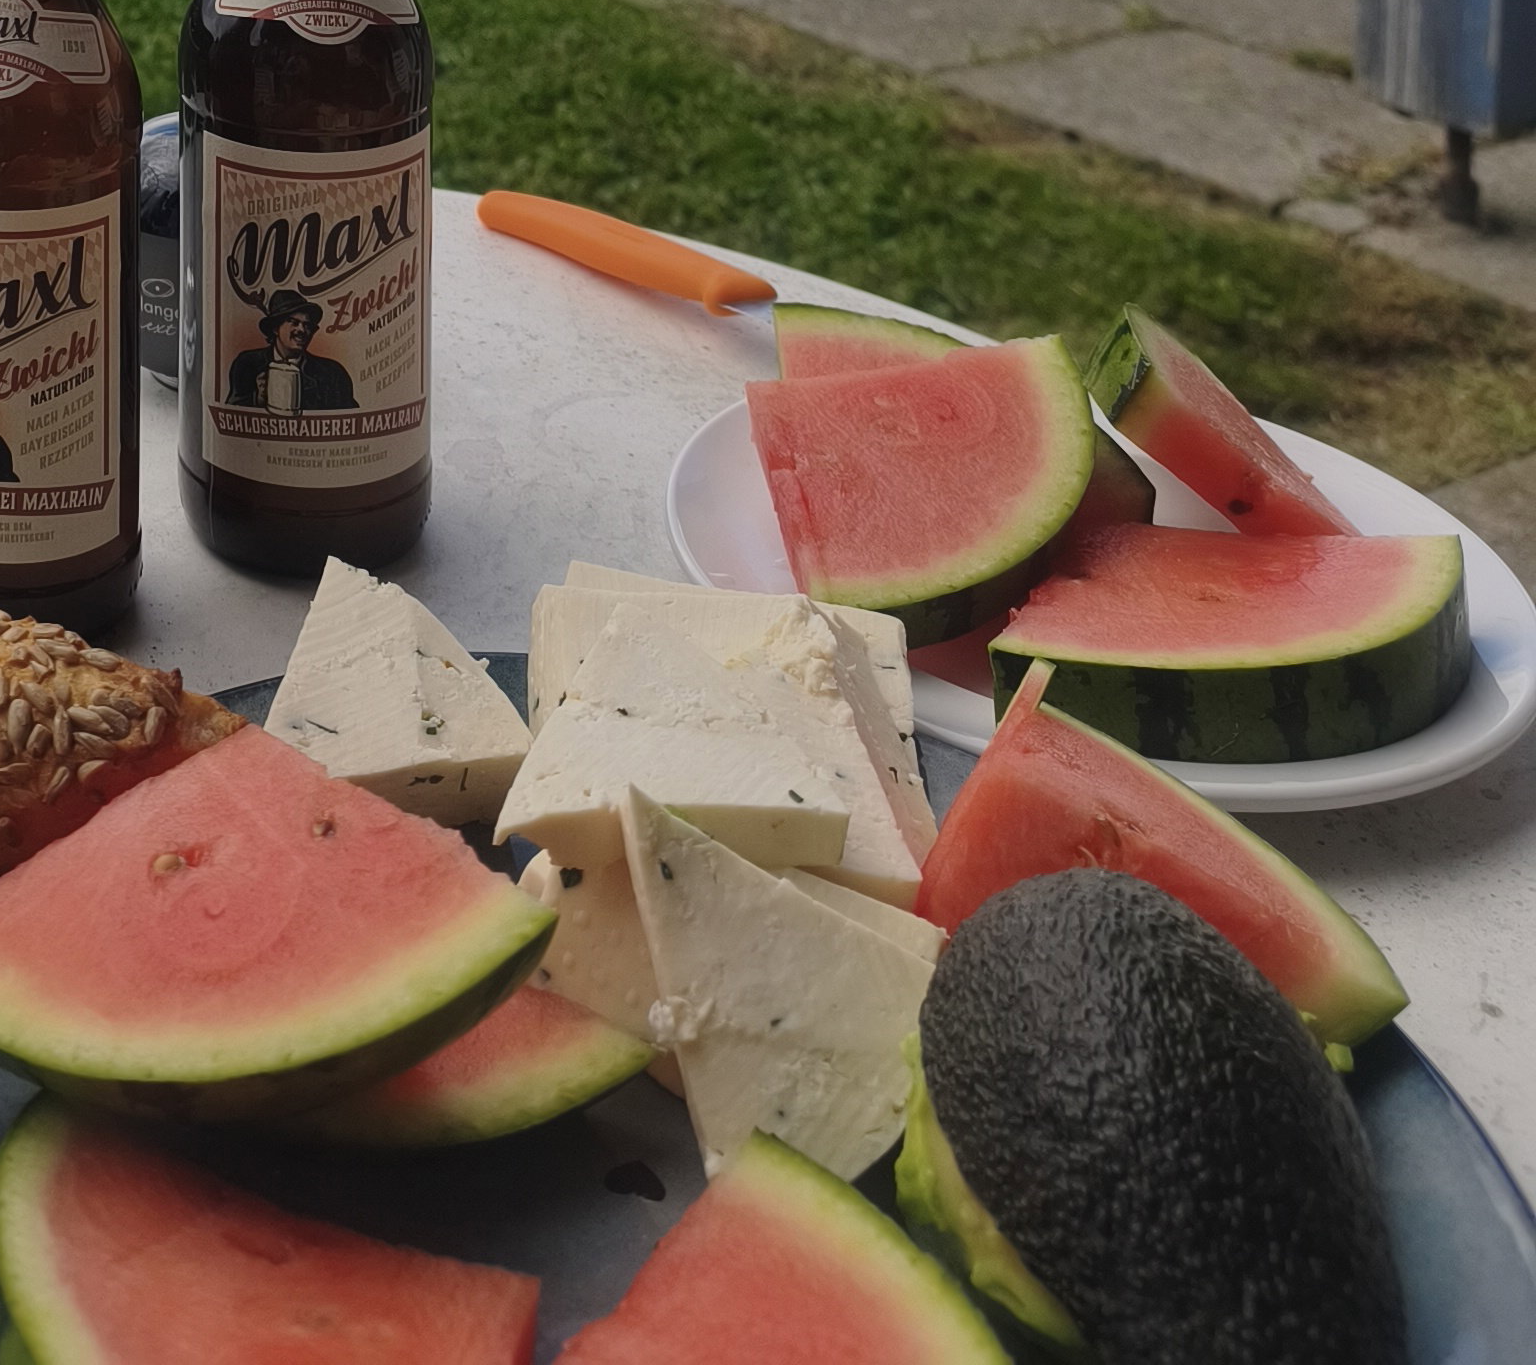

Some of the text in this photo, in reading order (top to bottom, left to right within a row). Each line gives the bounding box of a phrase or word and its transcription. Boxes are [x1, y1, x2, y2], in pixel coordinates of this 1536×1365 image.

[305, 14, 349, 27] ZWICKL
[247, 190, 321, 216] ORIGINAL
[227, 169, 417, 296] Maxl
[325, 247, 420, 334] Zwickl
[26, 390, 95, 433] NACH ALTER
[218, 404, 422, 438] SCHLOSSBRAUEREI MAXLRAIN
[20, 410, 95, 456] BAYERISCHER
[39, 430, 95, 470] REZEPTUR
[22, 484, 104, 512] MAXLRAIN
